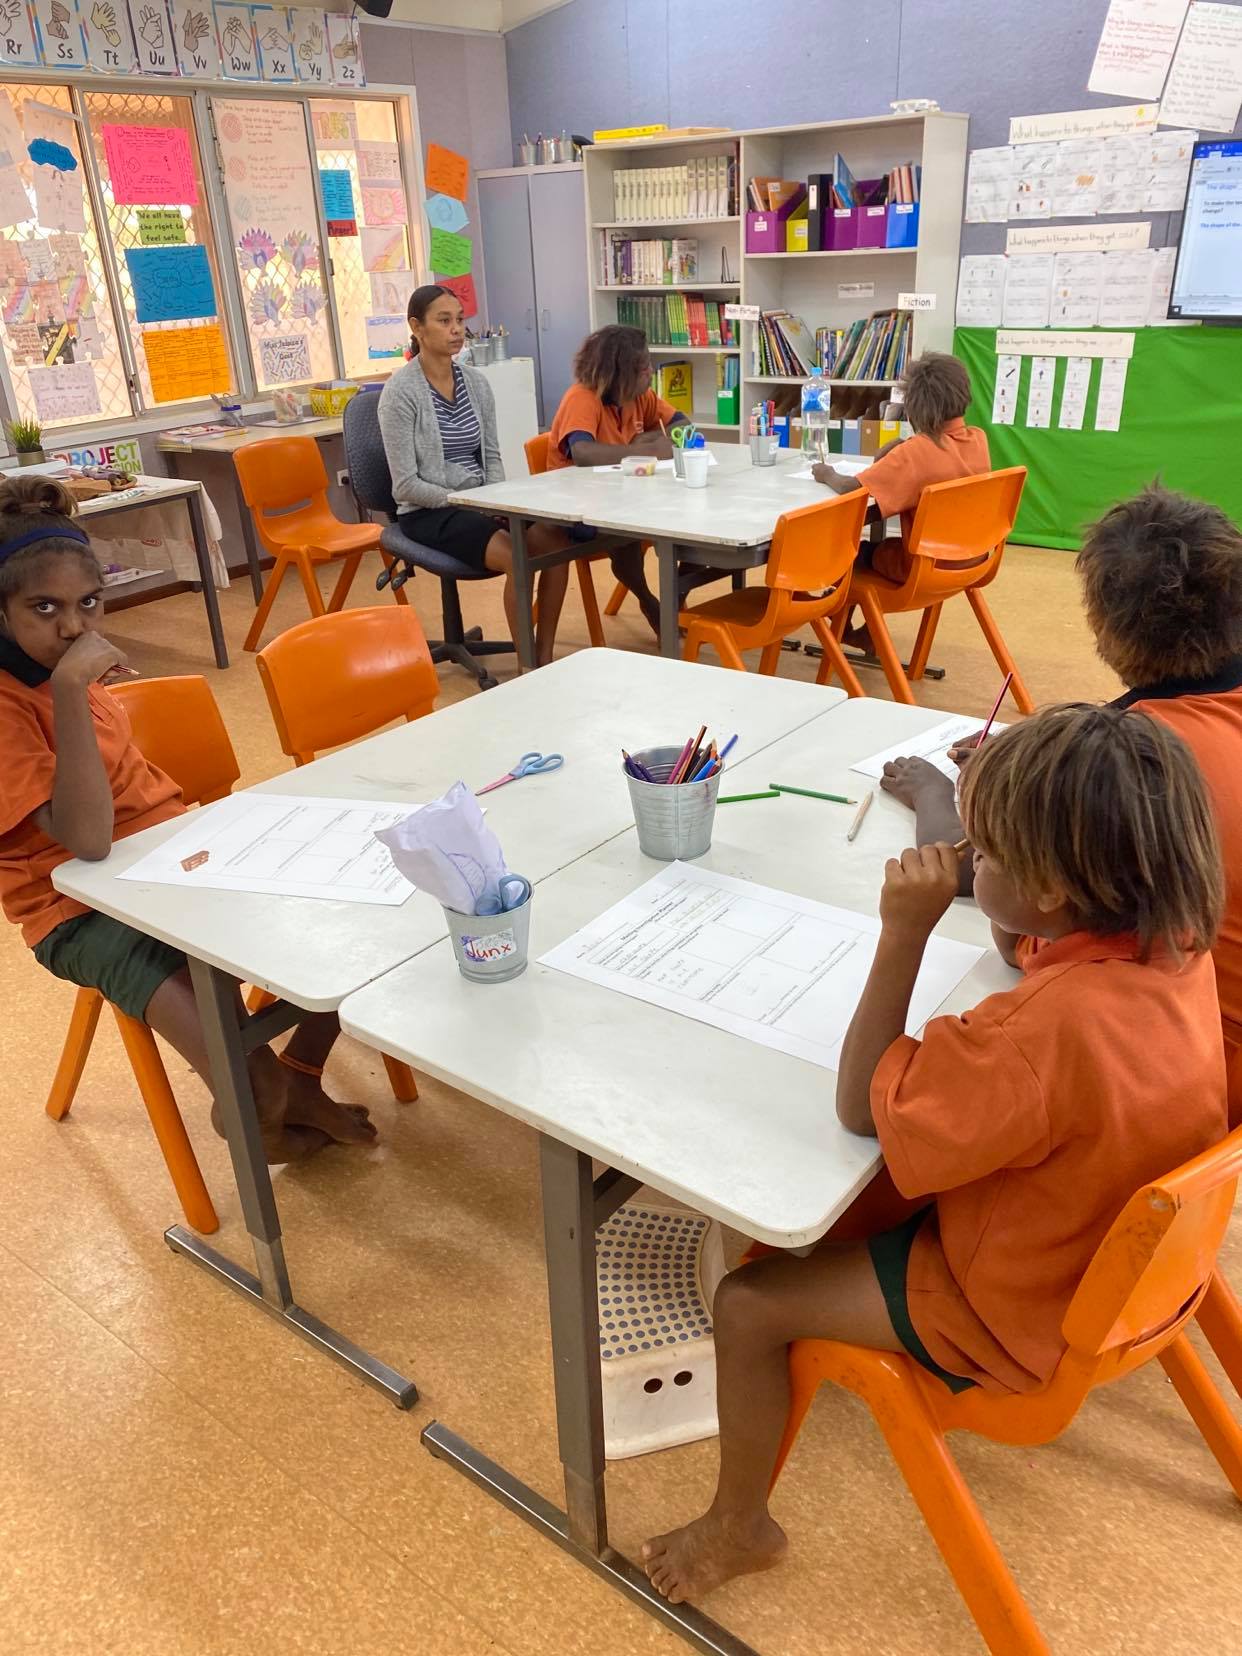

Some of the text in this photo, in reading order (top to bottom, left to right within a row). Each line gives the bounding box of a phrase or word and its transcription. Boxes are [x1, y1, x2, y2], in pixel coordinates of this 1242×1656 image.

[6, 39, 22, 55] Rr
[57, 43, 74, 59] Ss
[104, 50, 119, 65] Tt
[149, 50, 165, 65] Uu
[193, 55, 207, 69] Vv
[231, 57, 251, 71] Ww
[272, 60, 286, 73] Xx
[308, 63, 322, 80] Yy
[341, 65, 355, 78] Zz
[155, 223, 173, 231] right
[904, 296, 931, 306] Fiction
